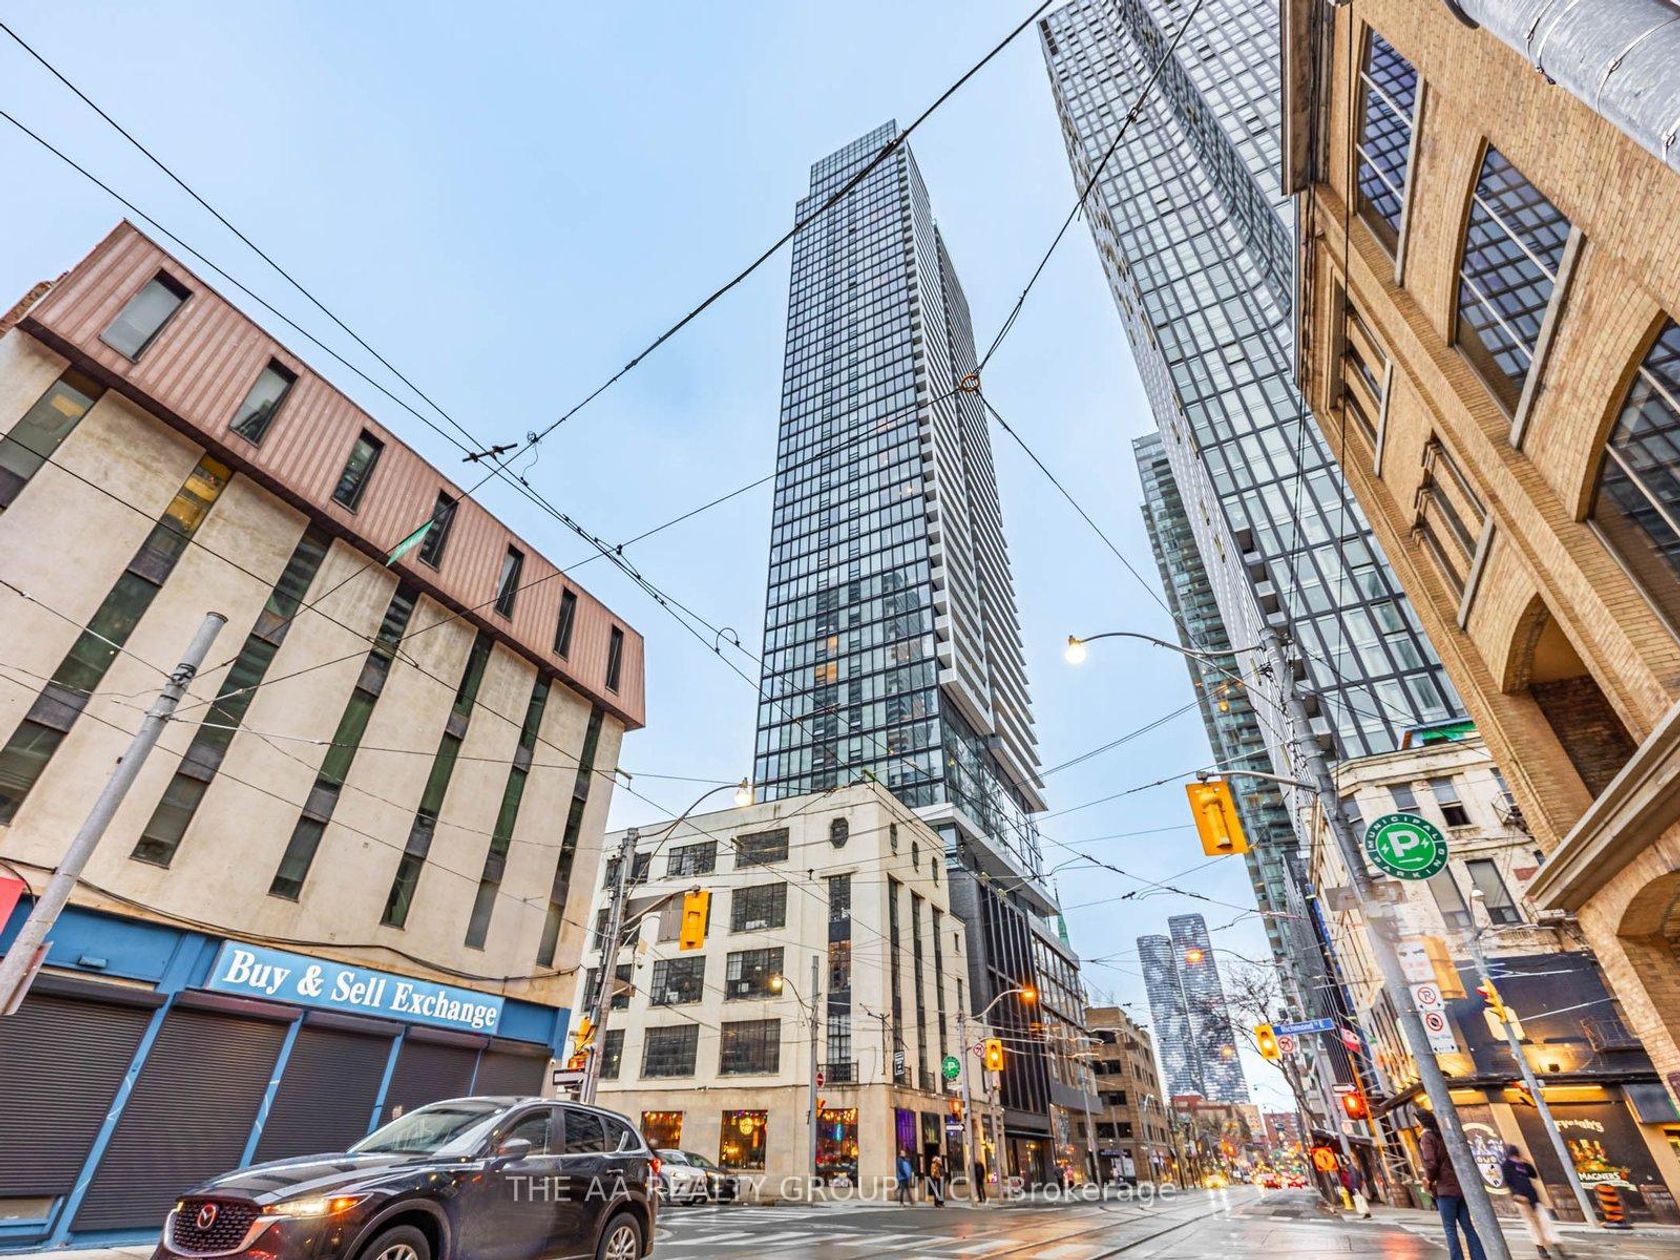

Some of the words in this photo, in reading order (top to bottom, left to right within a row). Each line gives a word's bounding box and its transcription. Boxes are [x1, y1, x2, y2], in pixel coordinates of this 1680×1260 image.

[1367, 816, 1438, 849] MUNICIPAL
[1387, 830, 1419, 857] P
[222, 949, 291, 995] Buy
[296, 965, 325, 997] &
[330, 970, 384, 1008] Sell
[389, 980, 498, 1029] Exchange
[1280, 1022, 1314, 1034] Richmond
